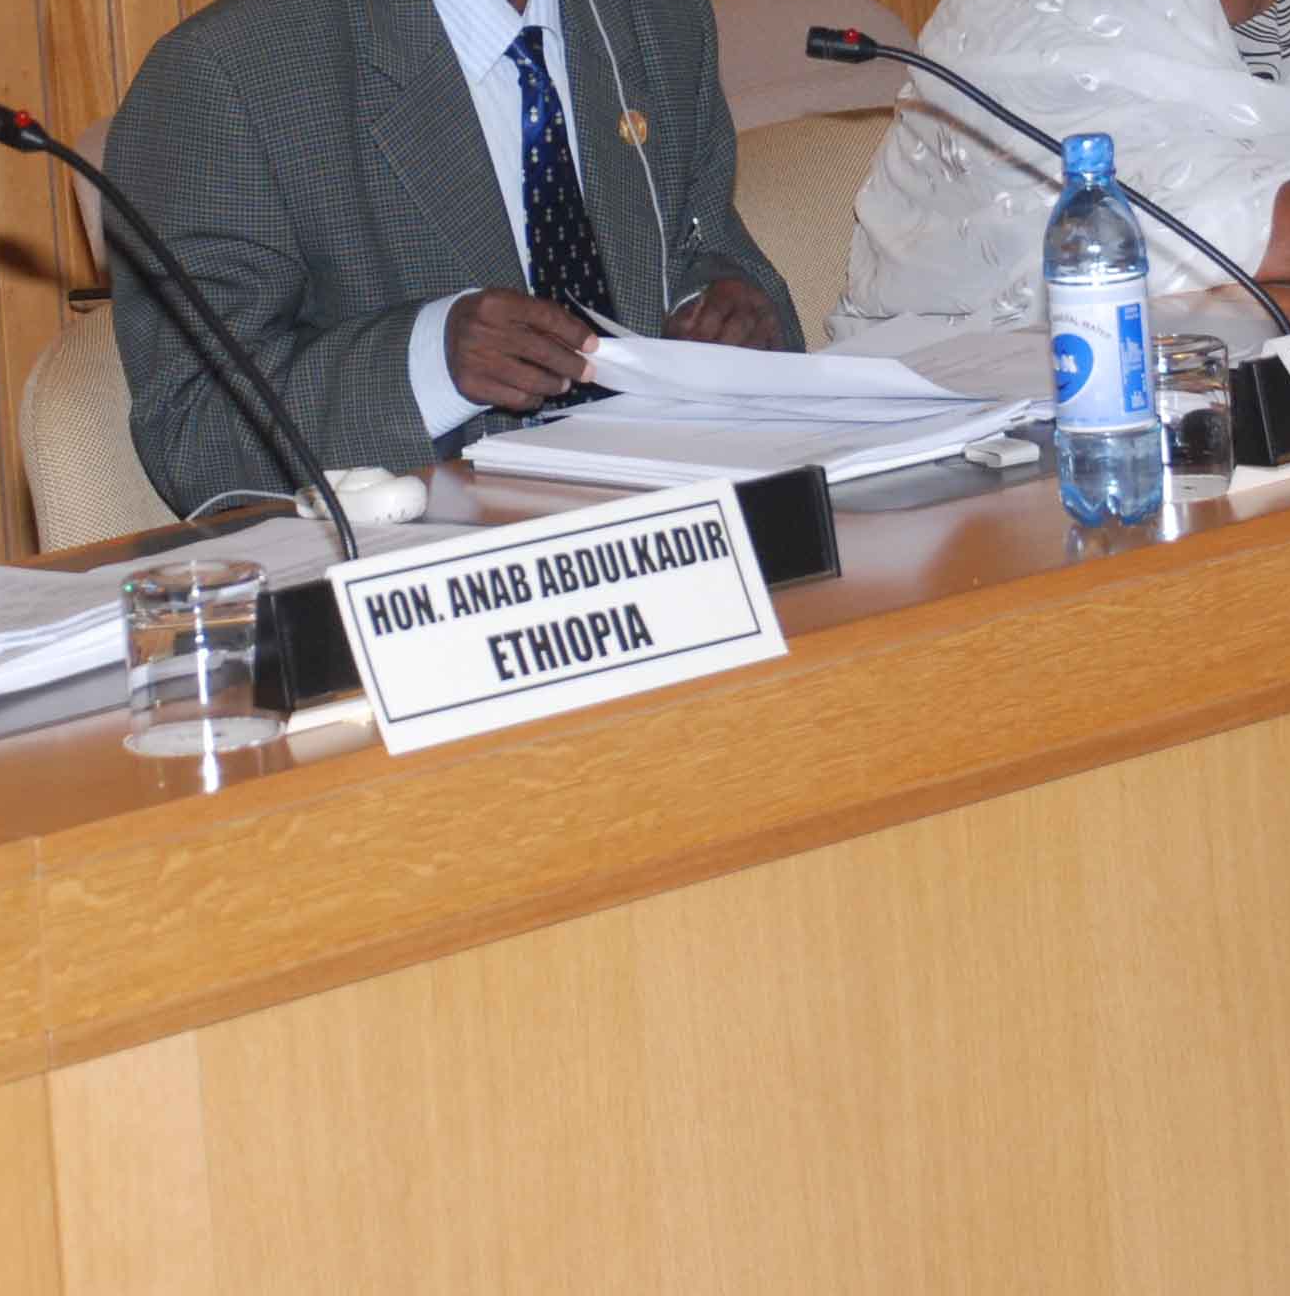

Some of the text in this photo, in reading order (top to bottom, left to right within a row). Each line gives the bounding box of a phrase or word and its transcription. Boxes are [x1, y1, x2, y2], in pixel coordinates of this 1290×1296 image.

[365, 519, 730, 636] HON. ANAB ABDULKADIR
[487, 603, 654, 681] ETHIOPIA
